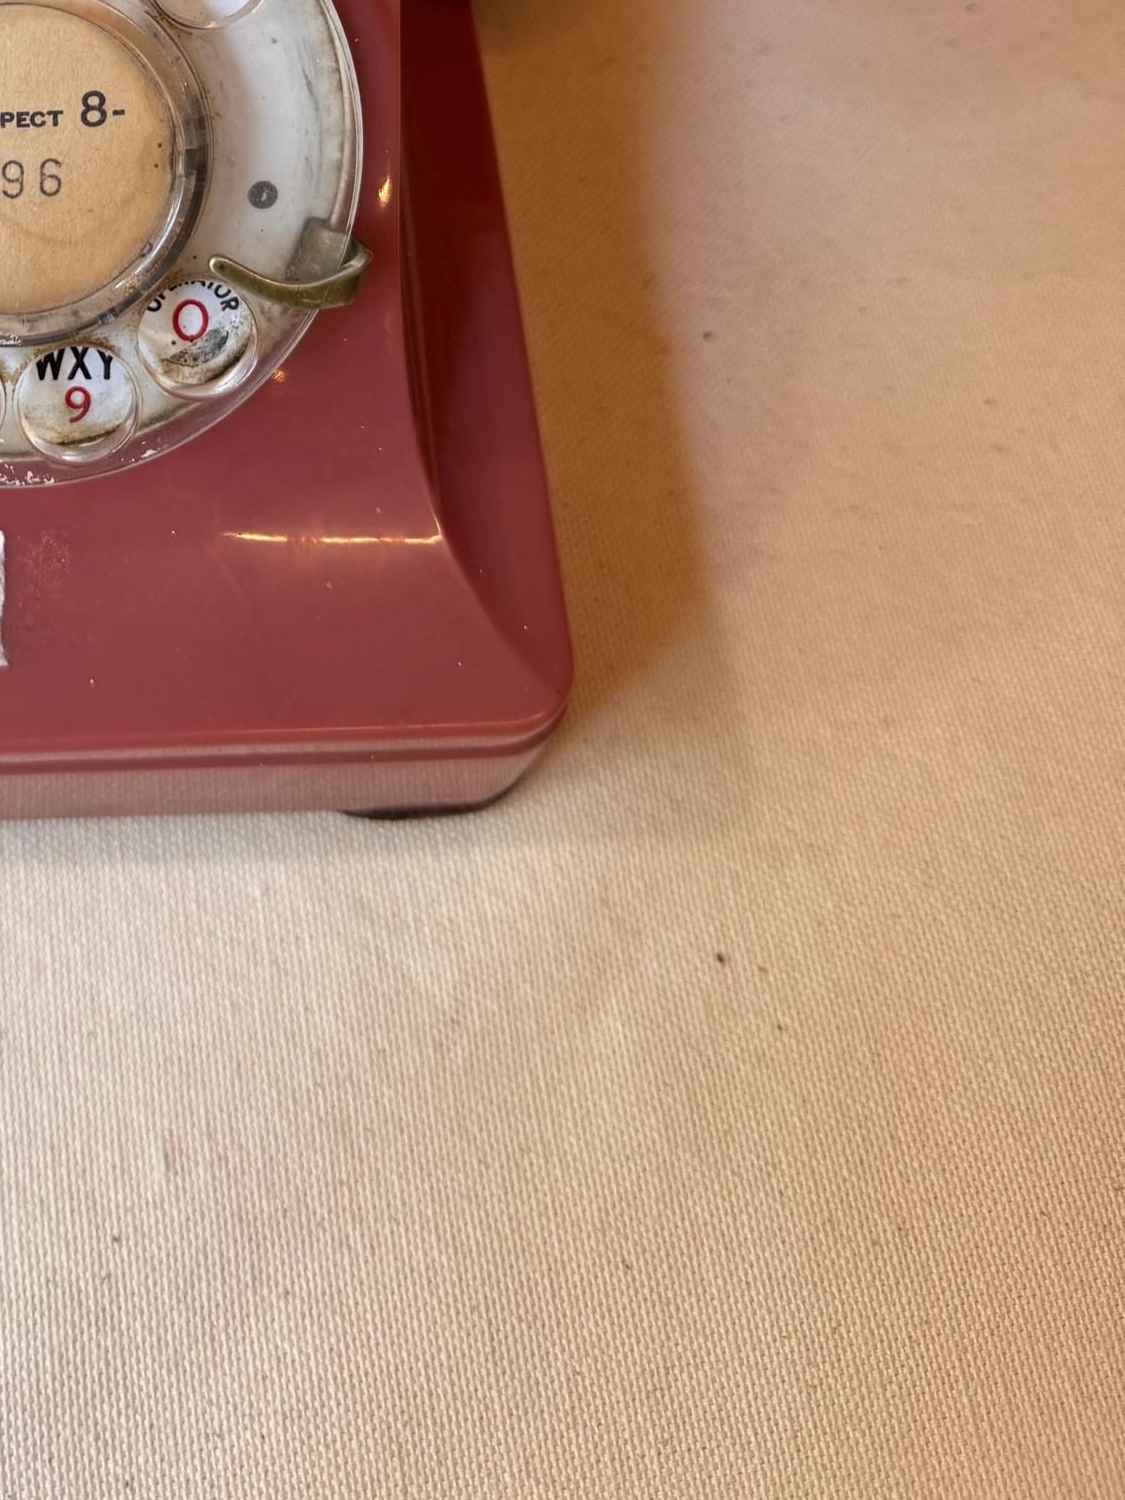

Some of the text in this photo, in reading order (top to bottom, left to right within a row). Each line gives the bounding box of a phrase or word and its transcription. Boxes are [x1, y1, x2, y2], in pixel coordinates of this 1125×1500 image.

[80, 90, 125, 127] 8-
[36, 346, 114, 380] WXY
[64, 386, 91, 423] 9
